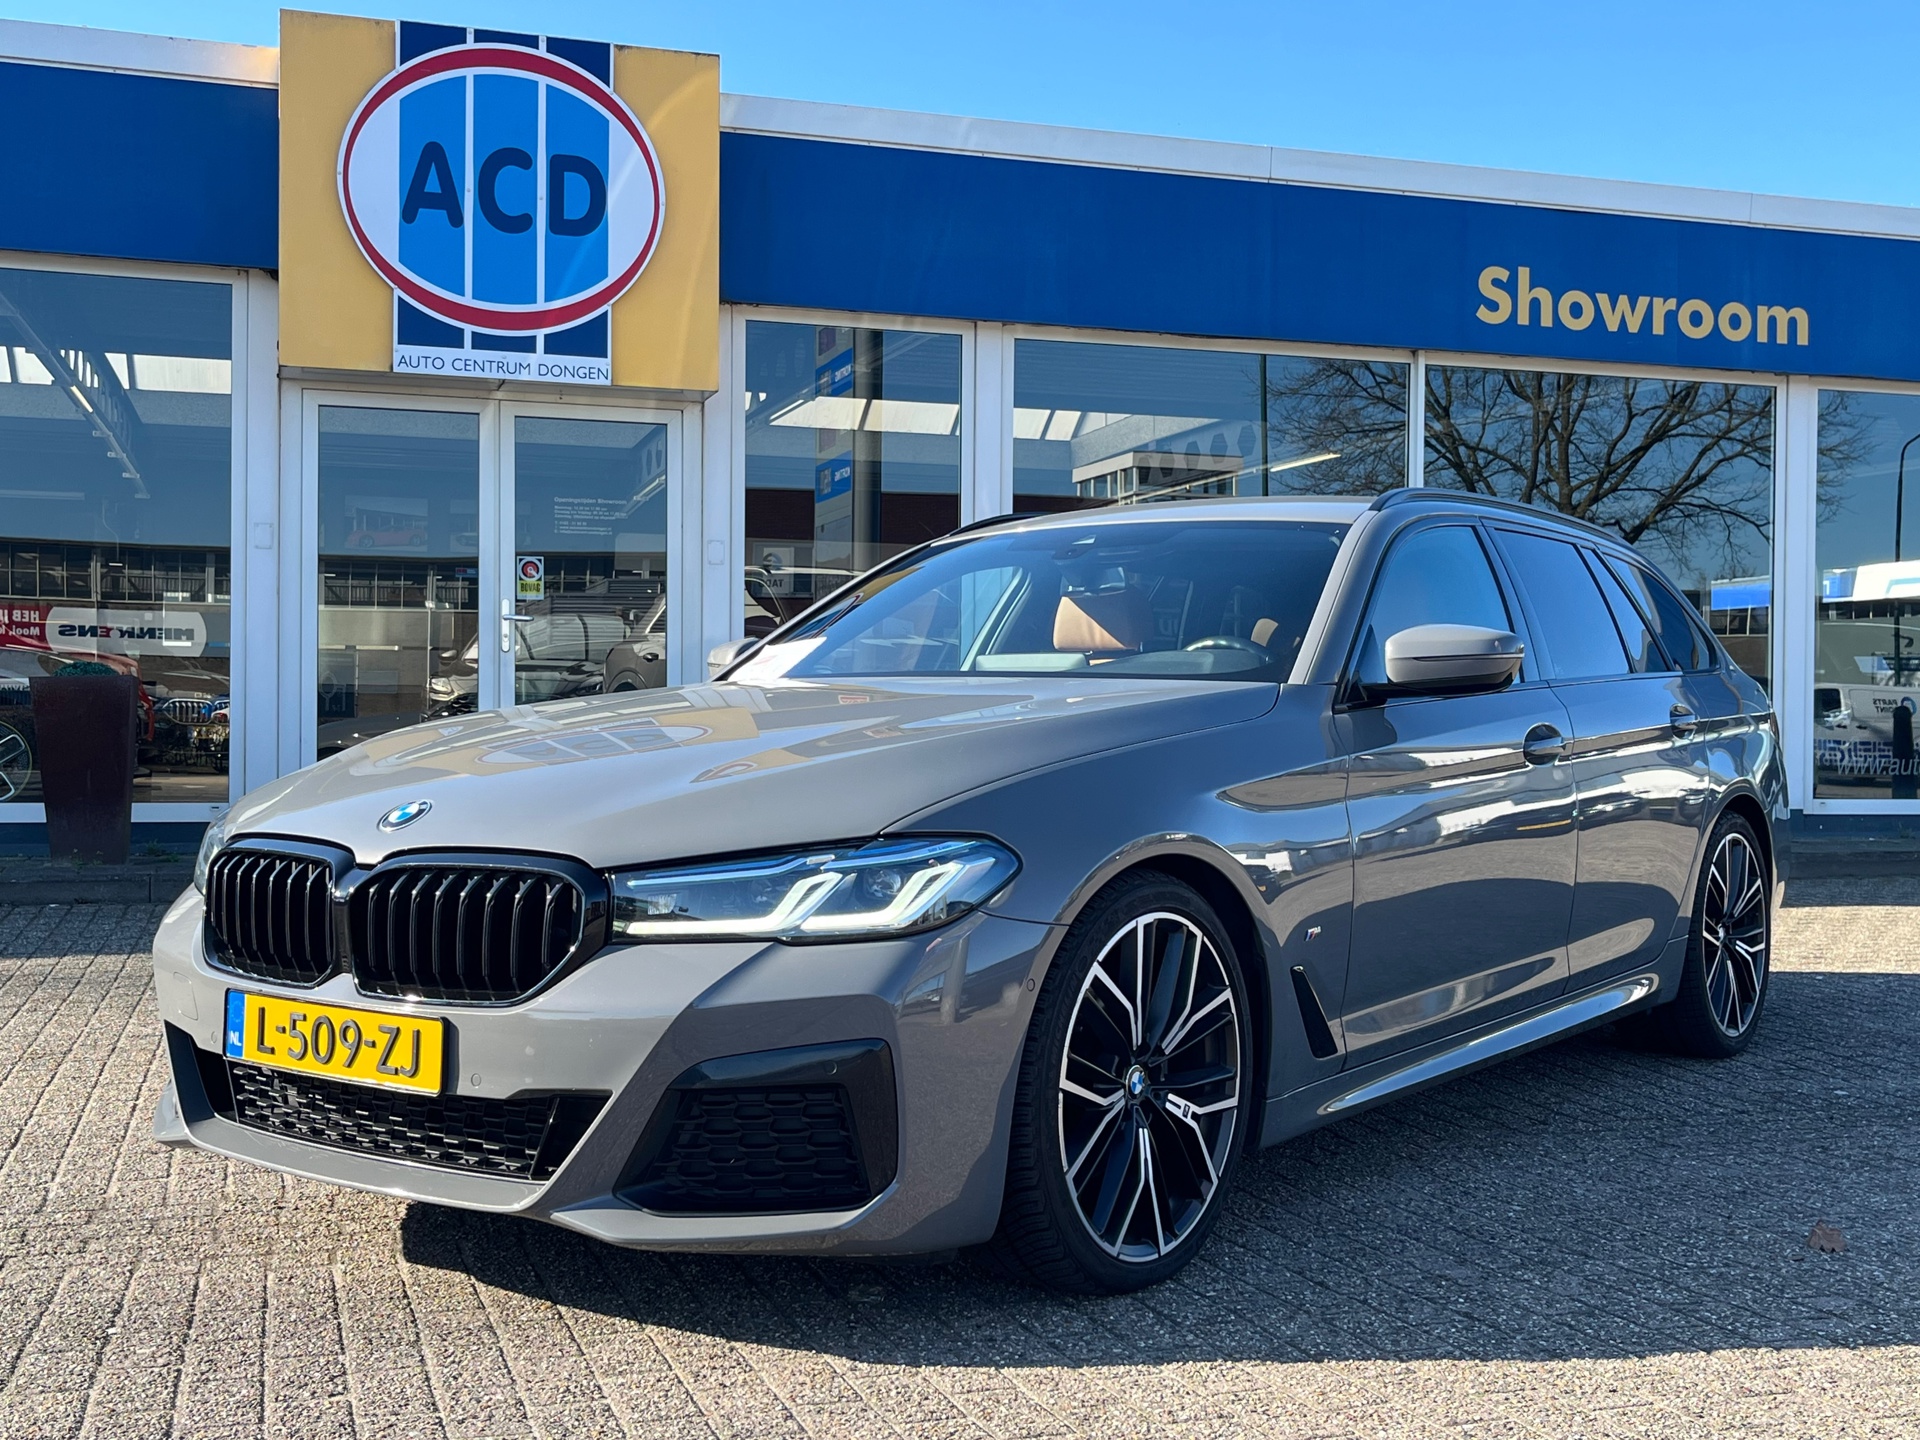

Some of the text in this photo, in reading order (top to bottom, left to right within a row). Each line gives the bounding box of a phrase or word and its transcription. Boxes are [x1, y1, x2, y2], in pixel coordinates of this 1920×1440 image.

[402, 141, 607, 237] ACD
[1475, 265, 1809, 346] Showroom
[397, 355, 609, 380] AUTO CENTRUM DONGEN
[520, 582, 541, 593] BOVAG
[1837, 754, 1920, 776] www.aut
[229, 1031, 242, 1046] NL
[257, 1006, 420, 1078] L-509-ZJ
